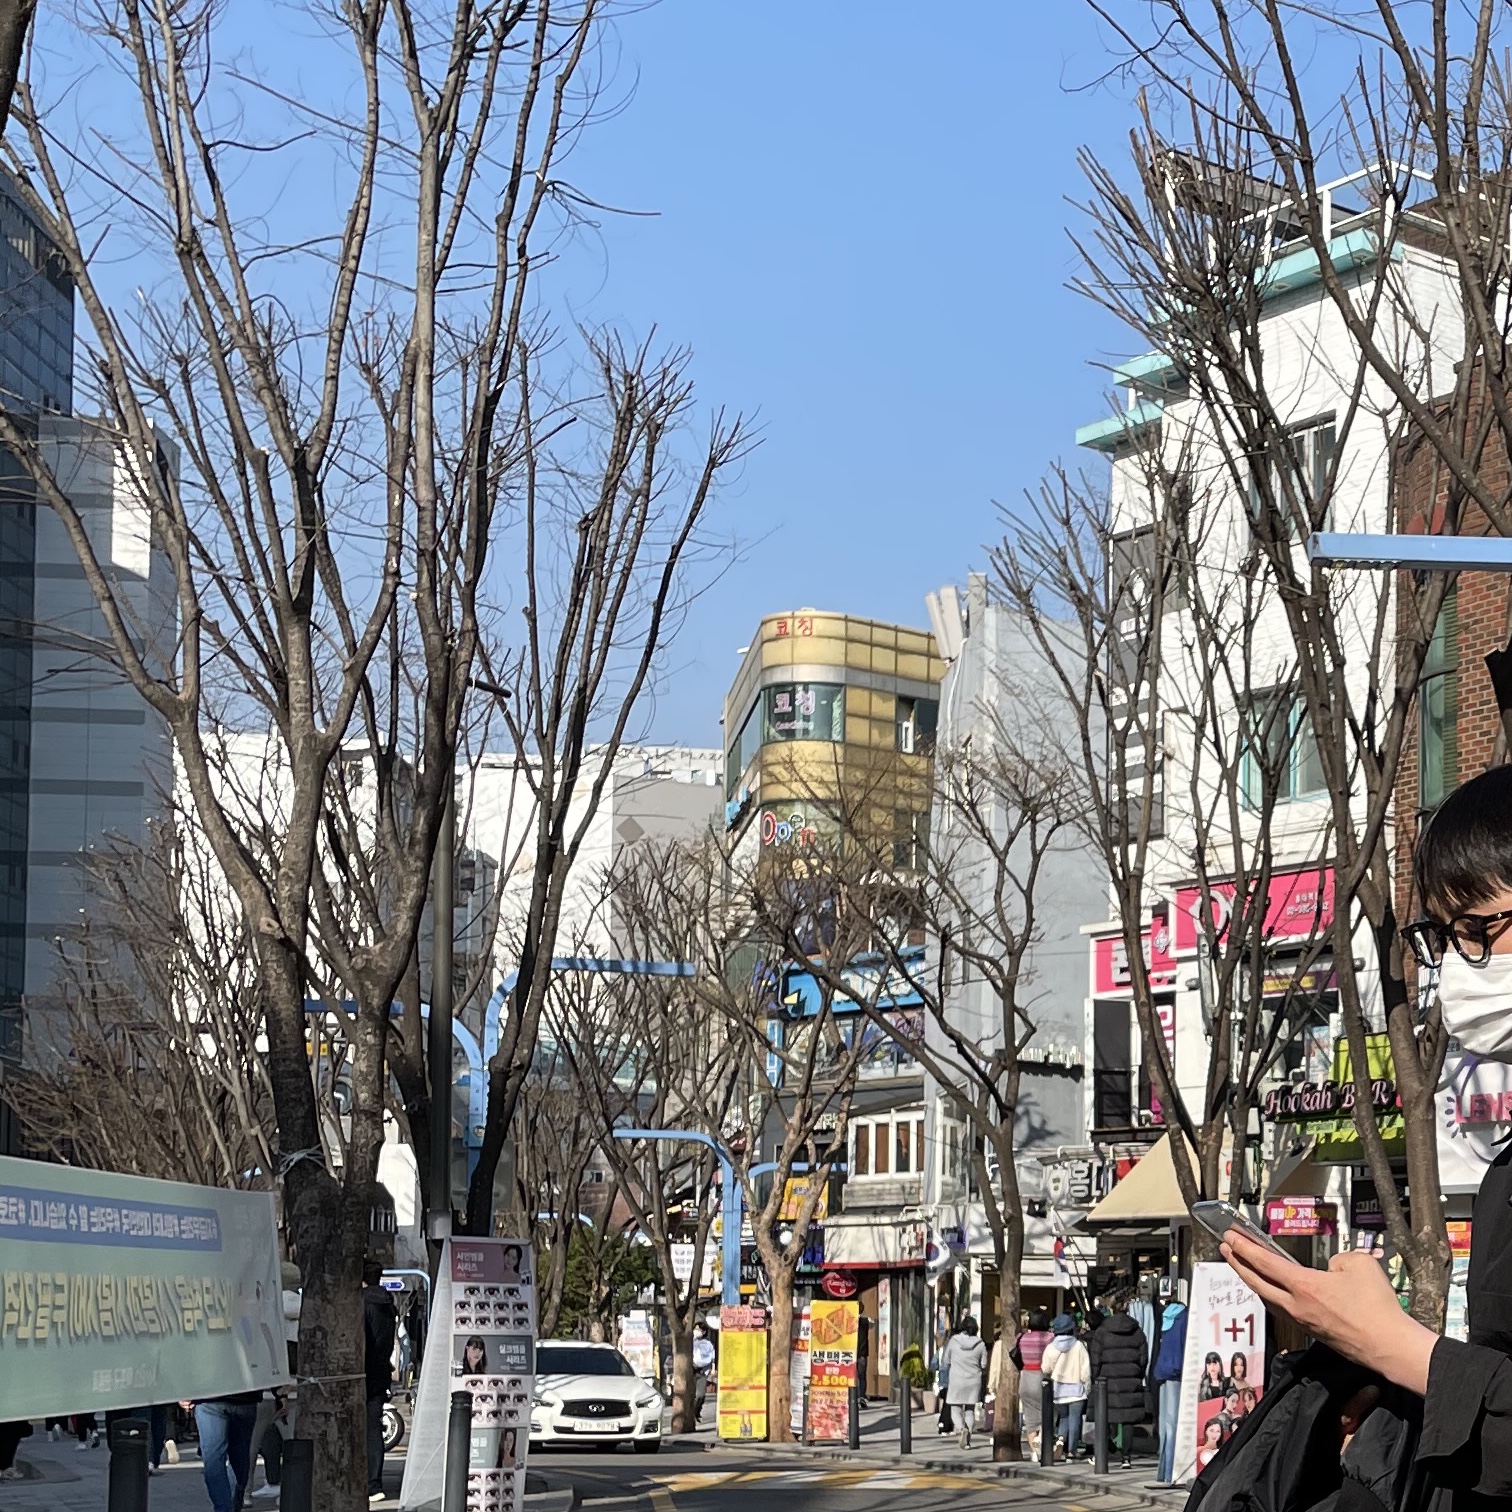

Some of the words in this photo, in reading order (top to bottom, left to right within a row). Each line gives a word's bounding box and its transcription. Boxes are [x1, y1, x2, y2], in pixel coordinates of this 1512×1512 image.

[1264, 1081, 1332, 1115] Hookah
[1341, 1080, 1389, 1108] BR
[1208, 1312, 1255, 1347] 1+1
[812, 1350, 854, 1364] 생맥주
